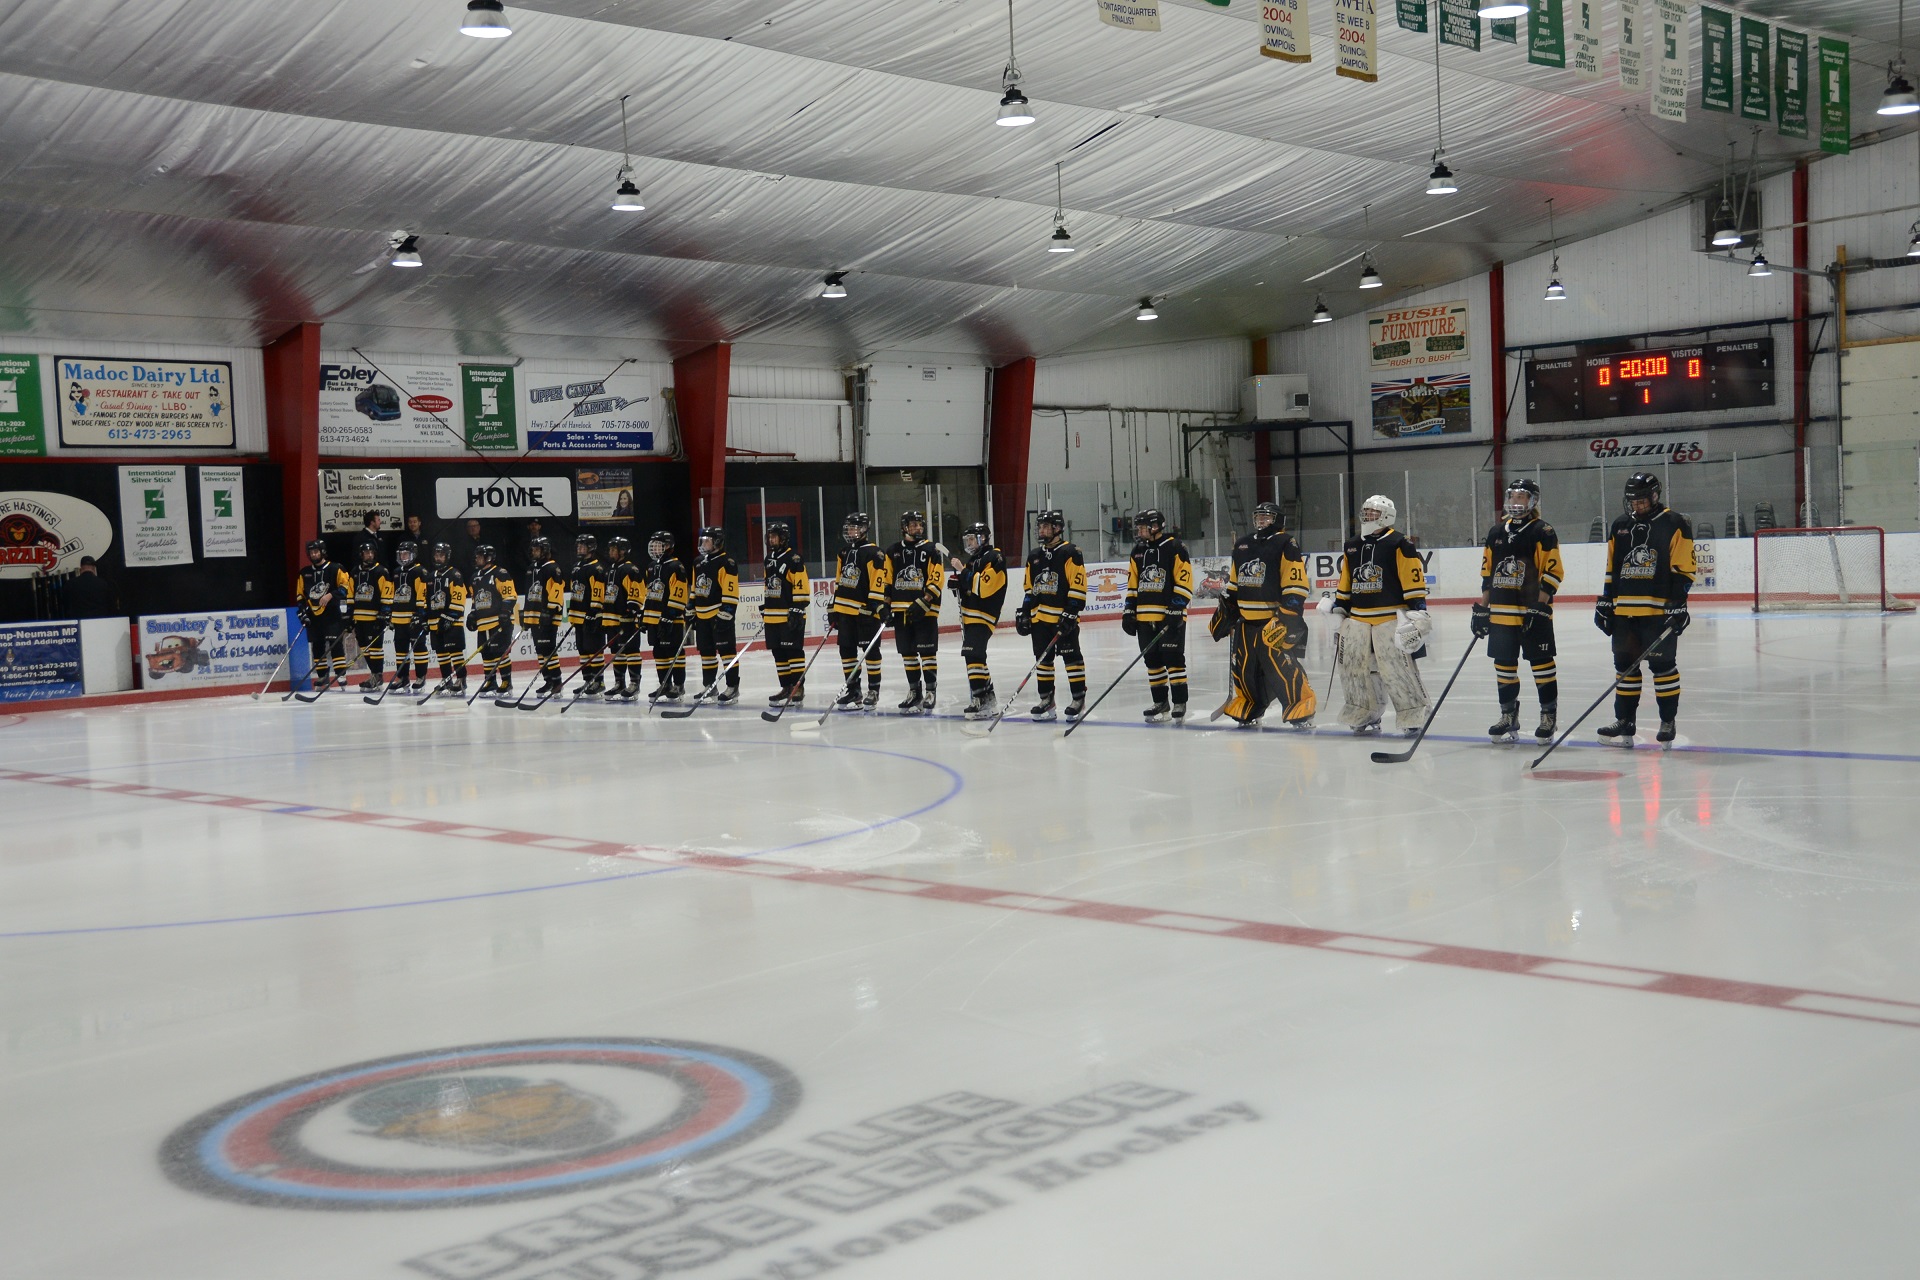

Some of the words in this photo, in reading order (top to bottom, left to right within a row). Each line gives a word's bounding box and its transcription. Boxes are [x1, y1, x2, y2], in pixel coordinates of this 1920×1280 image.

[1128, 6, 1156, 16] QUARTER
[1263, 6, 1292, 24] 2004
[1442, 2, 1478, 18] TOURNAMENT
[1112, 14, 1134, 25] FINALIST
[1348, 16, 1364, 28] WEE
[1448, 14, 1470, 28] NOVICE
[1340, 28, 1365, 44] 2004
[1452, 26, 1476, 40] DIVISION
[1444, 32, 1474, 48] FINALISTS
[1387, 306, 1448, 322] BUSH
[1381, 316, 1456, 342] FURNITURE
[1671, 348, 1703, 358] VISITOR
[1716, 342, 1759, 352] PENALTIES
[1536, 361, 1572, 370] PENALTIES
[1586, 357, 1610, 367] HOME
[1620, 357, 1668, 378] 20:00
[1762, 358, 1767, 366] 1
[64, 364, 128, 382] Madoc
[132, 366, 186, 386] Dairy
[190, 368, 226, 384] Ltd.
[1688, 360, 1700, 378] 0
[320, 364, 379, 390] Foley
[1599, 368, 1610, 386] 0
[1530, 380, 1535, 388] 1
[1762, 382, 1768, 390] 2
[96, 389, 149, 399] RESTAURANT
[162, 390, 182, 399] TAKE
[184, 392, 200, 400] OUT
[530, 384, 564, 404] UPPER
[566, 380, 606, 400] CANADA
[1644, 388, 1649, 404] 1
[100, 402, 125, 410] Casual
[125, 402, 152, 412] Dining
[162, 402, 187, 410] LLBO
[574, 397, 614, 418] MARINE
[1530, 402, 1536, 410] 2
[160, 412, 188, 420] BURGERS
[568, 420, 592, 429] Havelock
[602, 420, 650, 429] 705-778-6000
[108, 429, 192, 440] 613-473-2963
[472, 432, 510, 442] Champions
[616, 442, 640, 450] Storage
[1590, 438, 1618, 452] GO
[1594, 442, 1700, 458] GRIZZLIES
[1672, 448, 1704, 463] GO
[467, 487, 544, 508] HOME
[14, 502, 56, 526] HASTINGS
[137, 539, 178, 550] Finalists
[206, 538, 244, 548] Champions
[0, 548, 58, 570] RIZZLIES
[920, 551, 927, 562] C
[779, 562, 786, 574] A
[1548, 558, 1558, 572] 2
[1620, 566, 1656, 575] HUSKIES
[1086, 568, 1104, 578] SCOTT
[1180, 569, 1191, 583] 27
[1290, 567, 1303, 582] 31
[489, 574, 495, 586] A
[1074, 572, 1084, 587] 51
[1493, 576, 1524, 586] HUSKIES
[592, 587, 602, 598] 91
[630, 588, 640, 598] 93
[673, 586, 684, 598] 13
[728, 582, 734, 592] 5
[452, 590, 462, 601] 28
[554, 590, 560, 599] 7
[226, 614, 280, 630] Towing
[61, 628, 78, 636] MP
[225, 632, 246, 642] Scrap
[247, 630, 274, 640] Salvage
[198, 665, 212, 675] 24
[214, 664, 240, 674] Hour
[242, 662, 278, 672] Service
[28, 688, 45, 700] for
[782, 1080, 1199, 1214] LEAGUE
[1003, 1101, 1263, 1193] Hockey
[402, 1147, 836, 1280] BRUCE
[806, 1090, 1021, 1157] LEE
